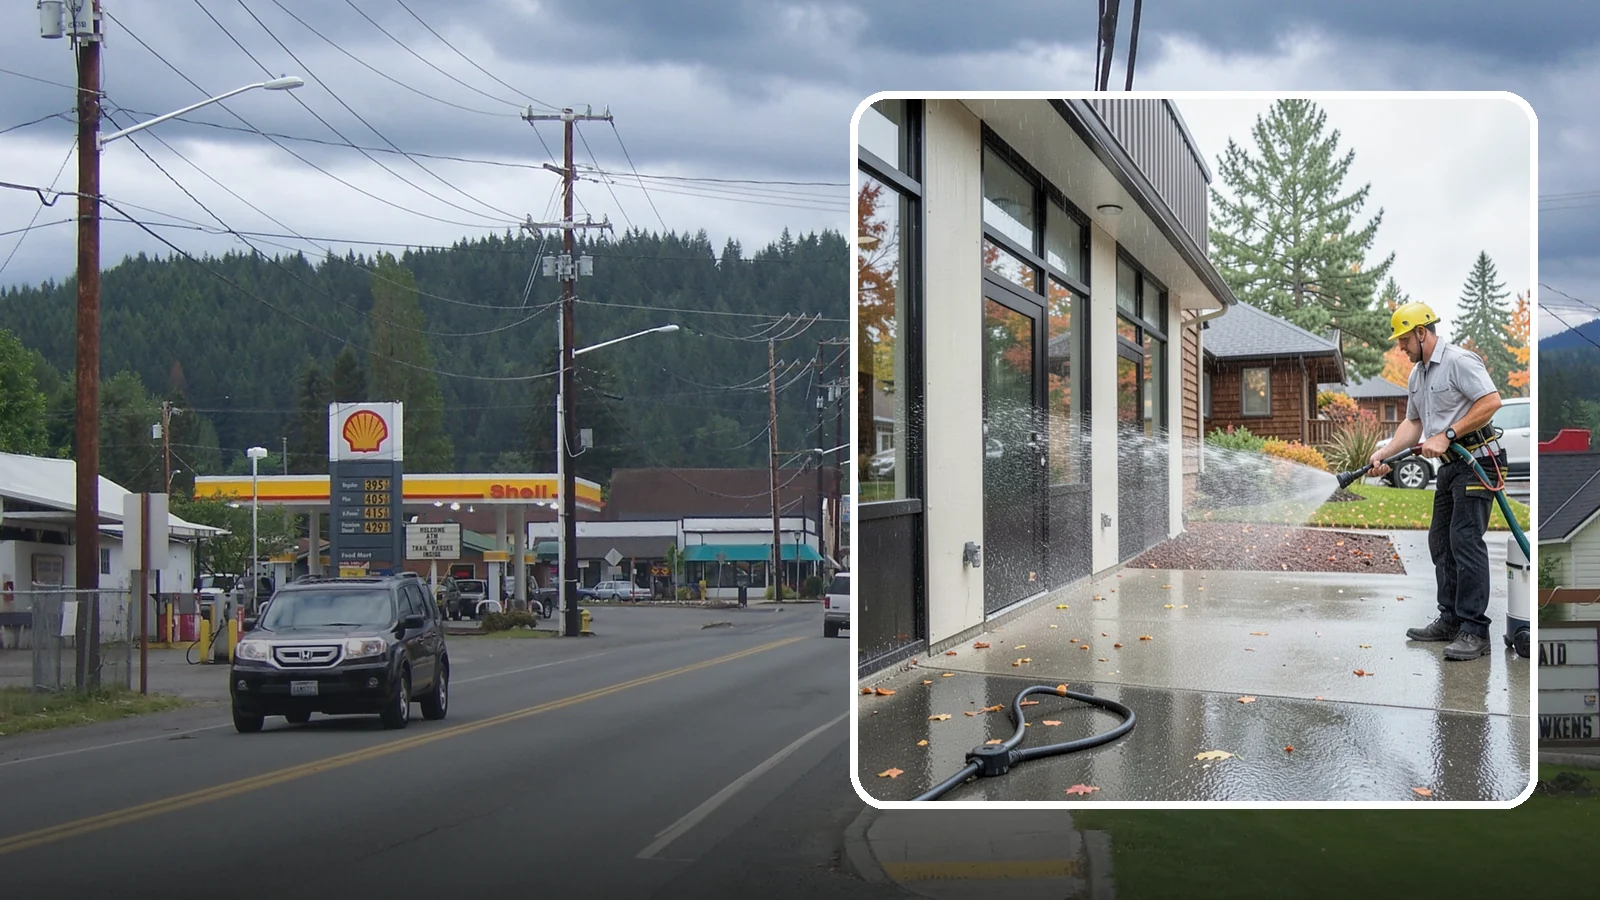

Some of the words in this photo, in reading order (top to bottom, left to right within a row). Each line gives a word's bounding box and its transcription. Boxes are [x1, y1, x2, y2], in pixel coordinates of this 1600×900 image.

[366, 480, 383, 490] 395
[490, 484, 547, 499] Shell
[366, 494, 383, 504] 405
[366, 508, 383, 518] 415
[366, 522, 383, 532] 429
